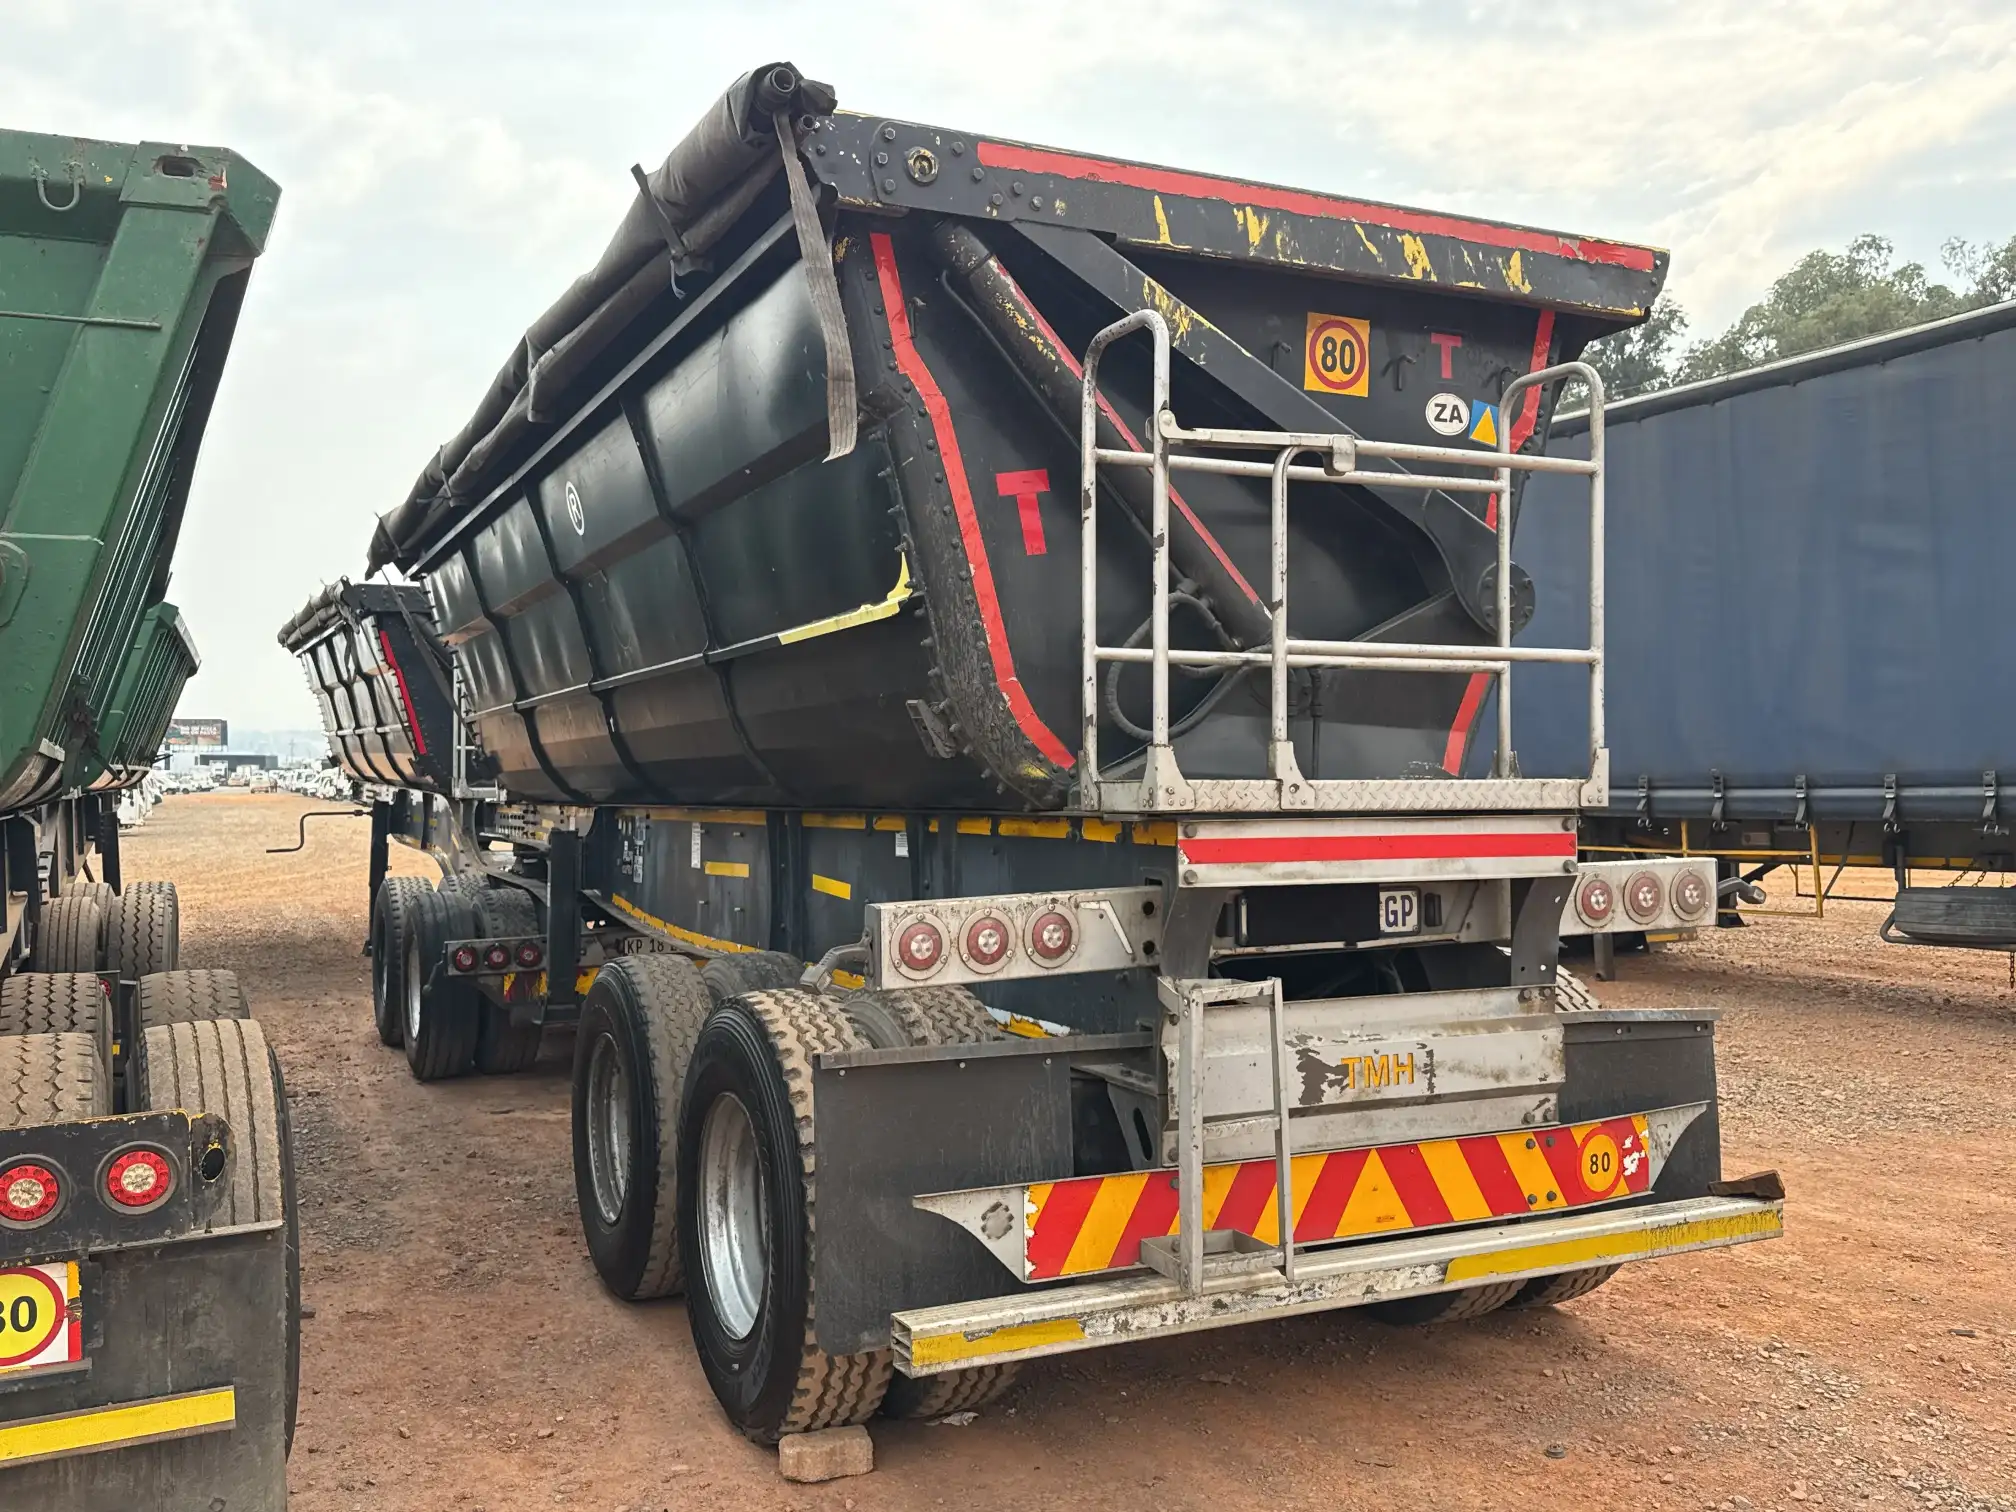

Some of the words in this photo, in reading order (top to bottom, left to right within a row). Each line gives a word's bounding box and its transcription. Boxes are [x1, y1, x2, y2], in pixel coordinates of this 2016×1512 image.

[1321, 336, 1356, 375] 80
[1430, 332, 1463, 380] T
[1434, 403, 1464, 425] ZA
[995, 468, 1051, 556] T
[1385, 894, 1414, 928] GP
[627, 939, 643, 954] KP
[1341, 1052, 1415, 1090] TMH
[1589, 1151, 1611, 1175] 80
[0, 1295, 38, 1334] 0
